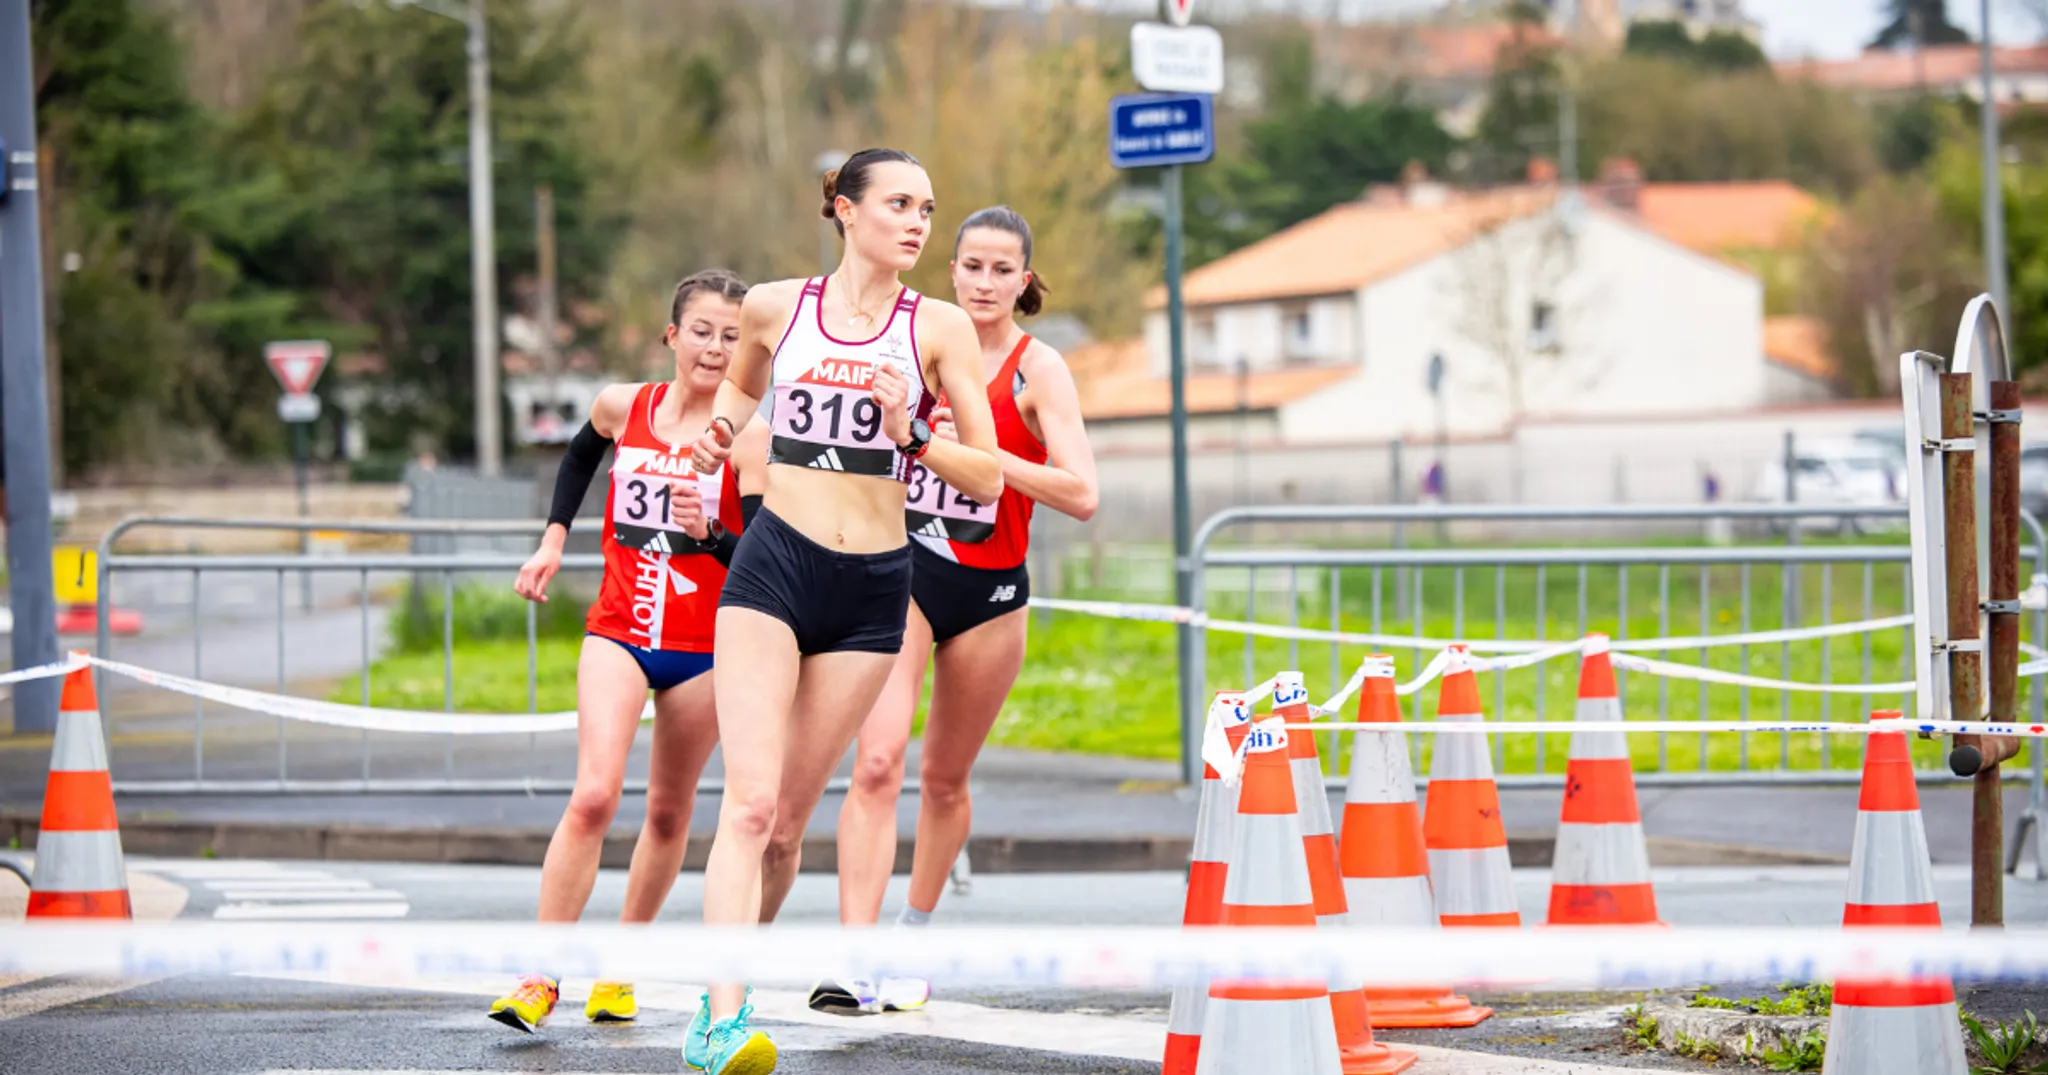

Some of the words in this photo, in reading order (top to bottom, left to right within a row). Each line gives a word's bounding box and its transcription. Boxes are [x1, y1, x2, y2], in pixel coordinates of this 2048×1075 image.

[812, 362, 874, 385] MAIF
[788, 388, 882, 443] 319
[625, 479, 688, 524] 31
